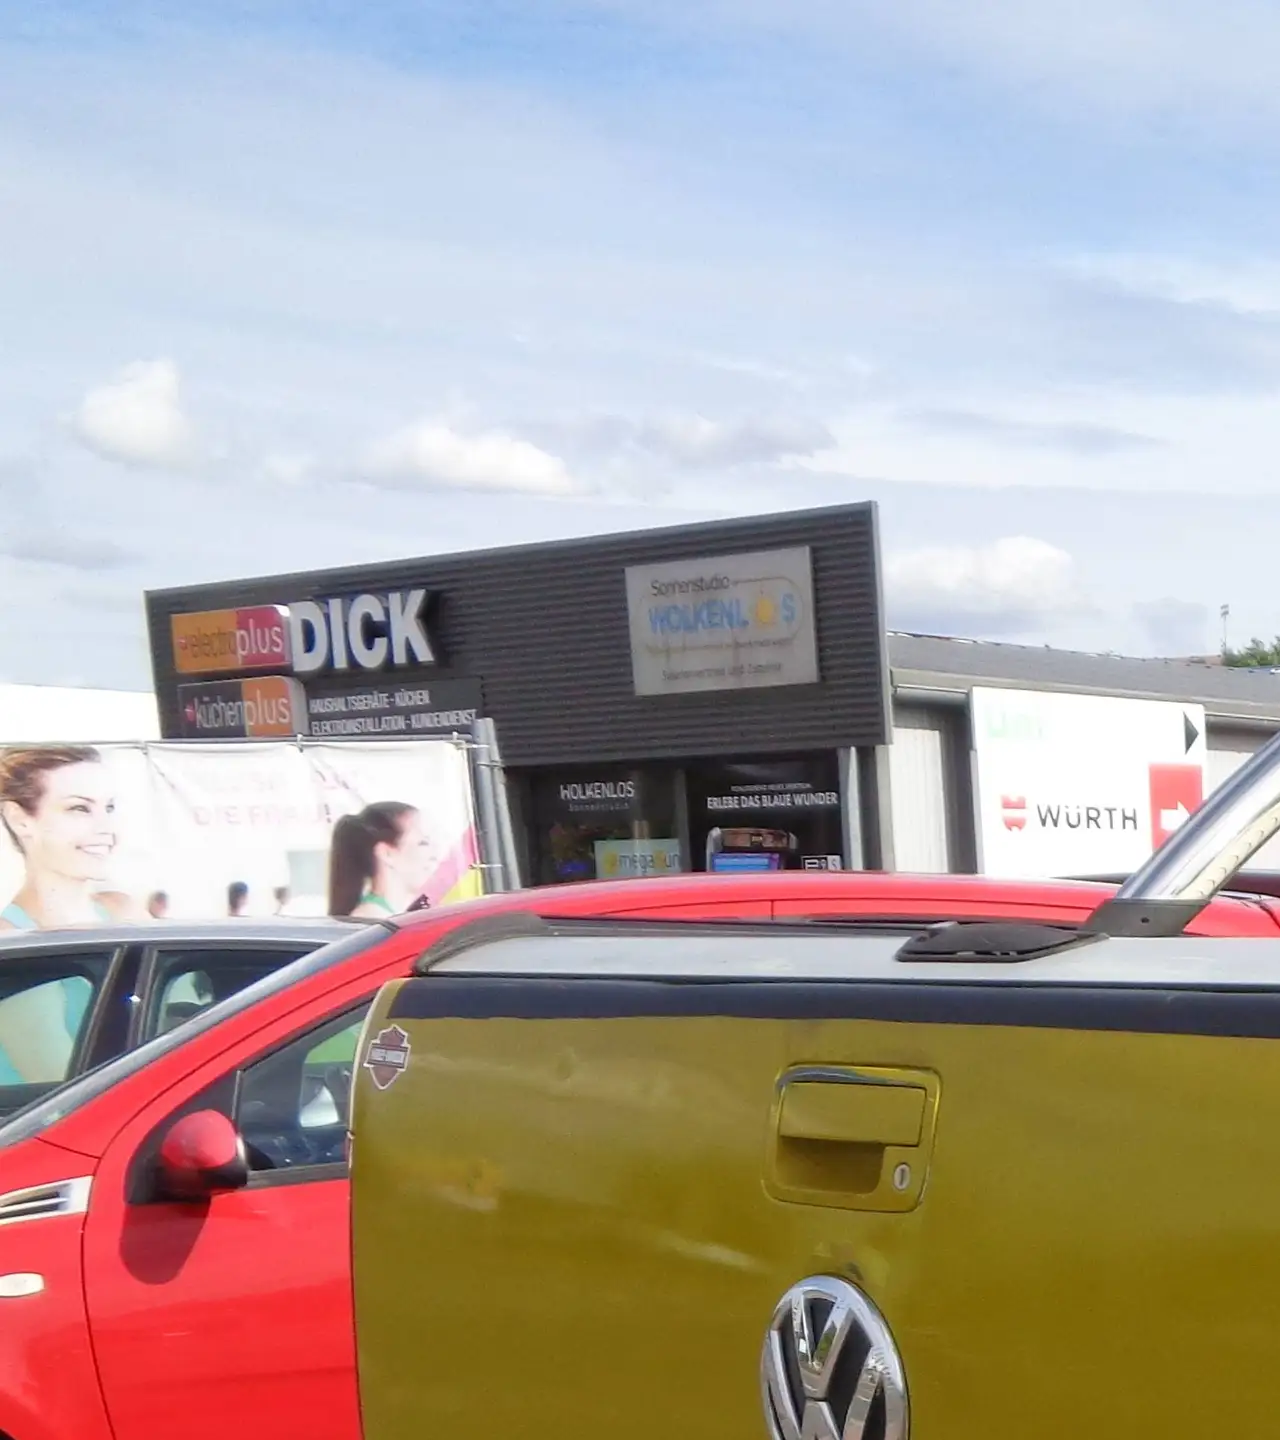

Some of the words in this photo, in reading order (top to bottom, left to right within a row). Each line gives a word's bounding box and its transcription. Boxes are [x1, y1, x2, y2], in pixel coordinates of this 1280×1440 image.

[287, 588, 435, 672] DICK
[560, 780, 636, 801] WOLKENLOS
[707, 796, 740, 810] ERLEBE
[741, 795, 761, 809] DAS
[793, 791, 838, 807] WUNDER
[1036, 802, 1139, 831] WÜRTH
